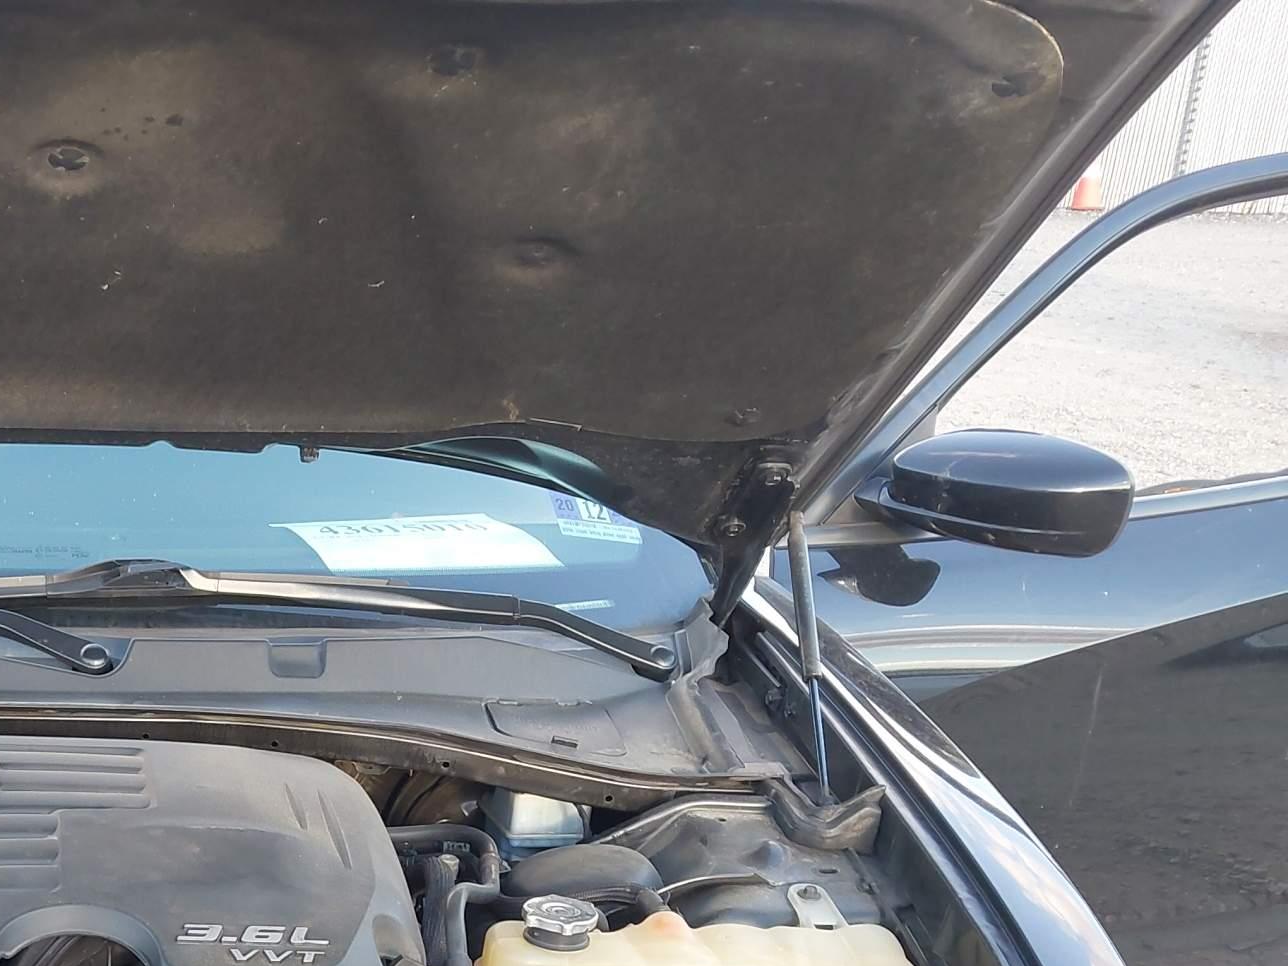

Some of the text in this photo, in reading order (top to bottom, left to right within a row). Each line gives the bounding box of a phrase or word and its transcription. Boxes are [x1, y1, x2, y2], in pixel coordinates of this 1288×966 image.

[555, 498, 574, 512] 20
[581, 501, 608, 521] 12
[176, 923, 330, 945] 3.6L
[229, 948, 326, 963] VVT
